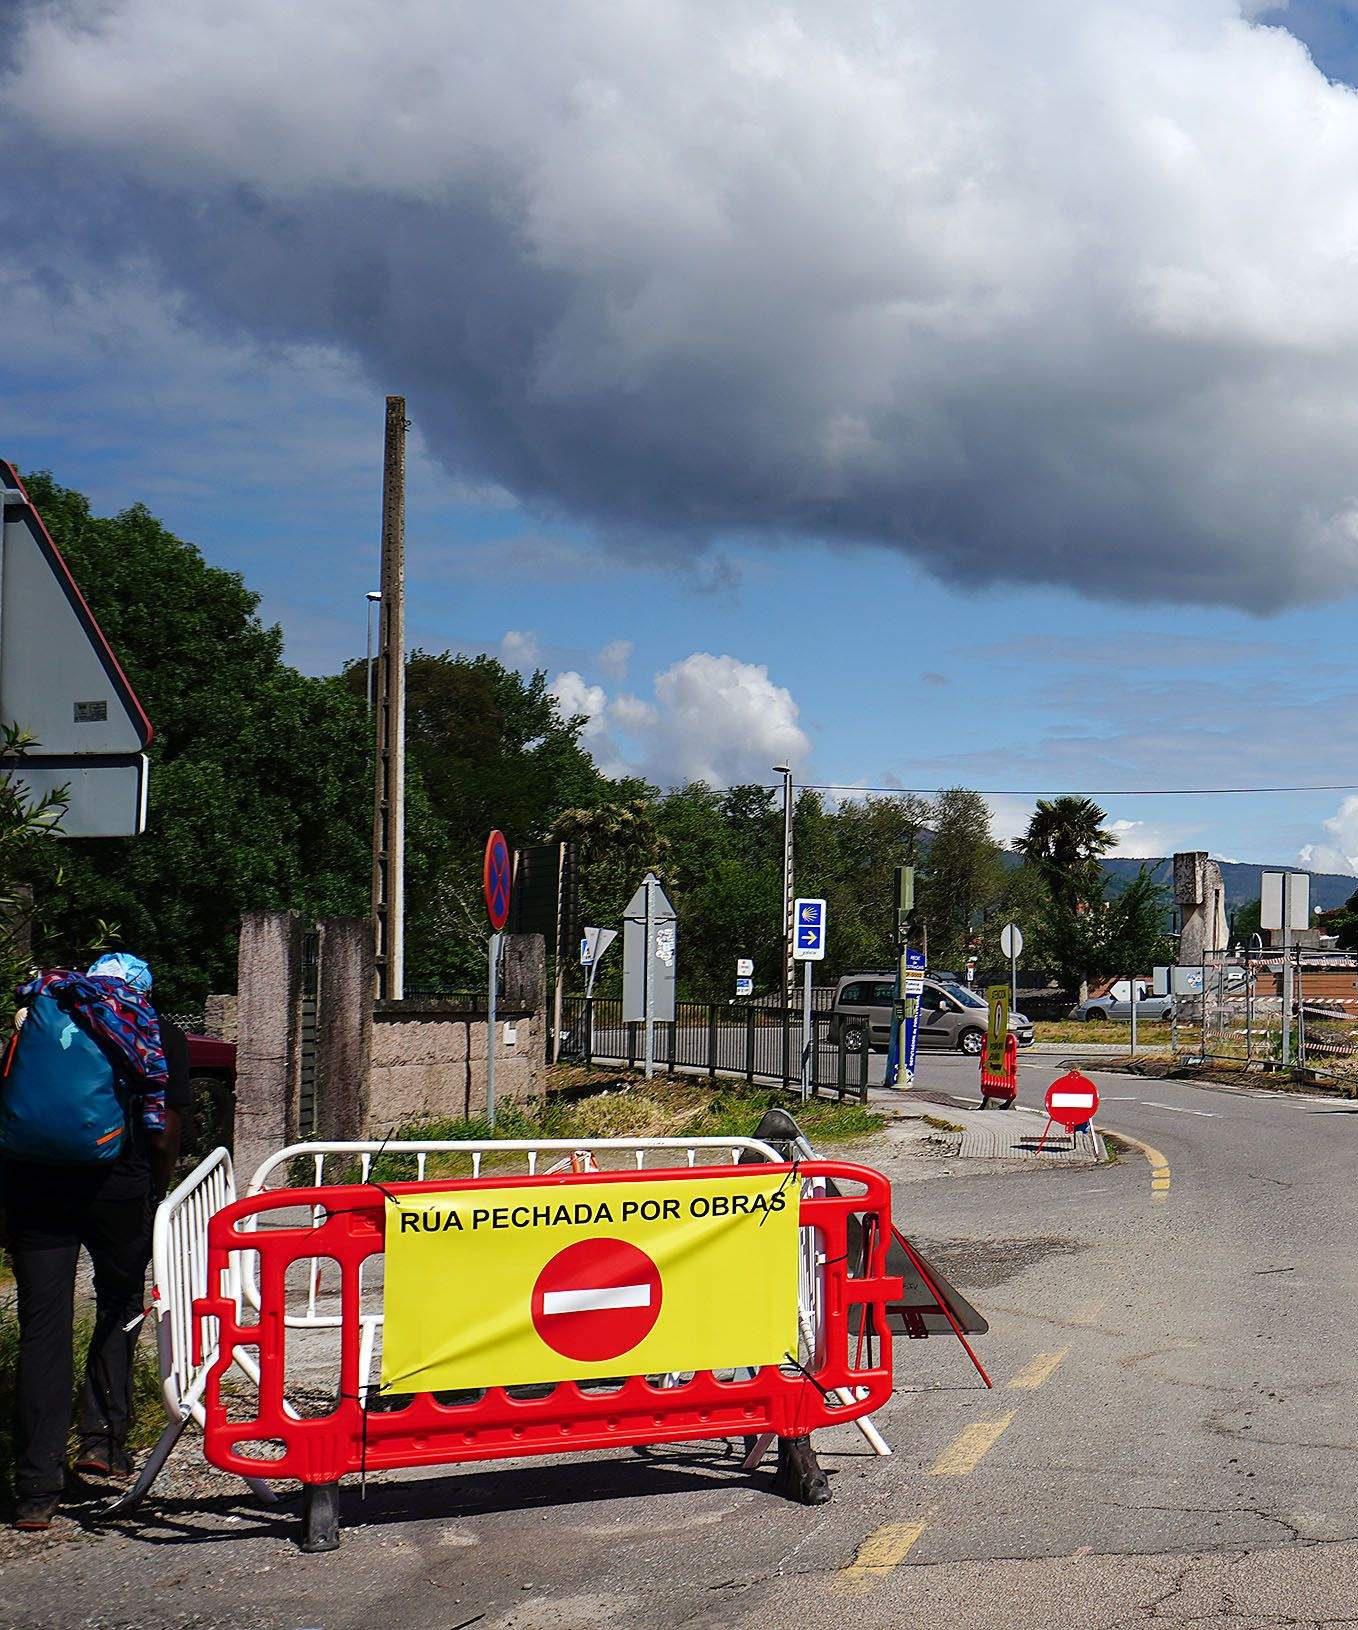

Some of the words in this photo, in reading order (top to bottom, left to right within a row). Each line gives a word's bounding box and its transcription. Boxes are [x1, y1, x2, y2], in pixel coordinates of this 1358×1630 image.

[401, 1205, 464, 1233] RÚA
[473, 1202, 611, 1230] PECHADA
[622, 1199, 681, 1222] POR
[690, 1191, 786, 1219] OBRAS
